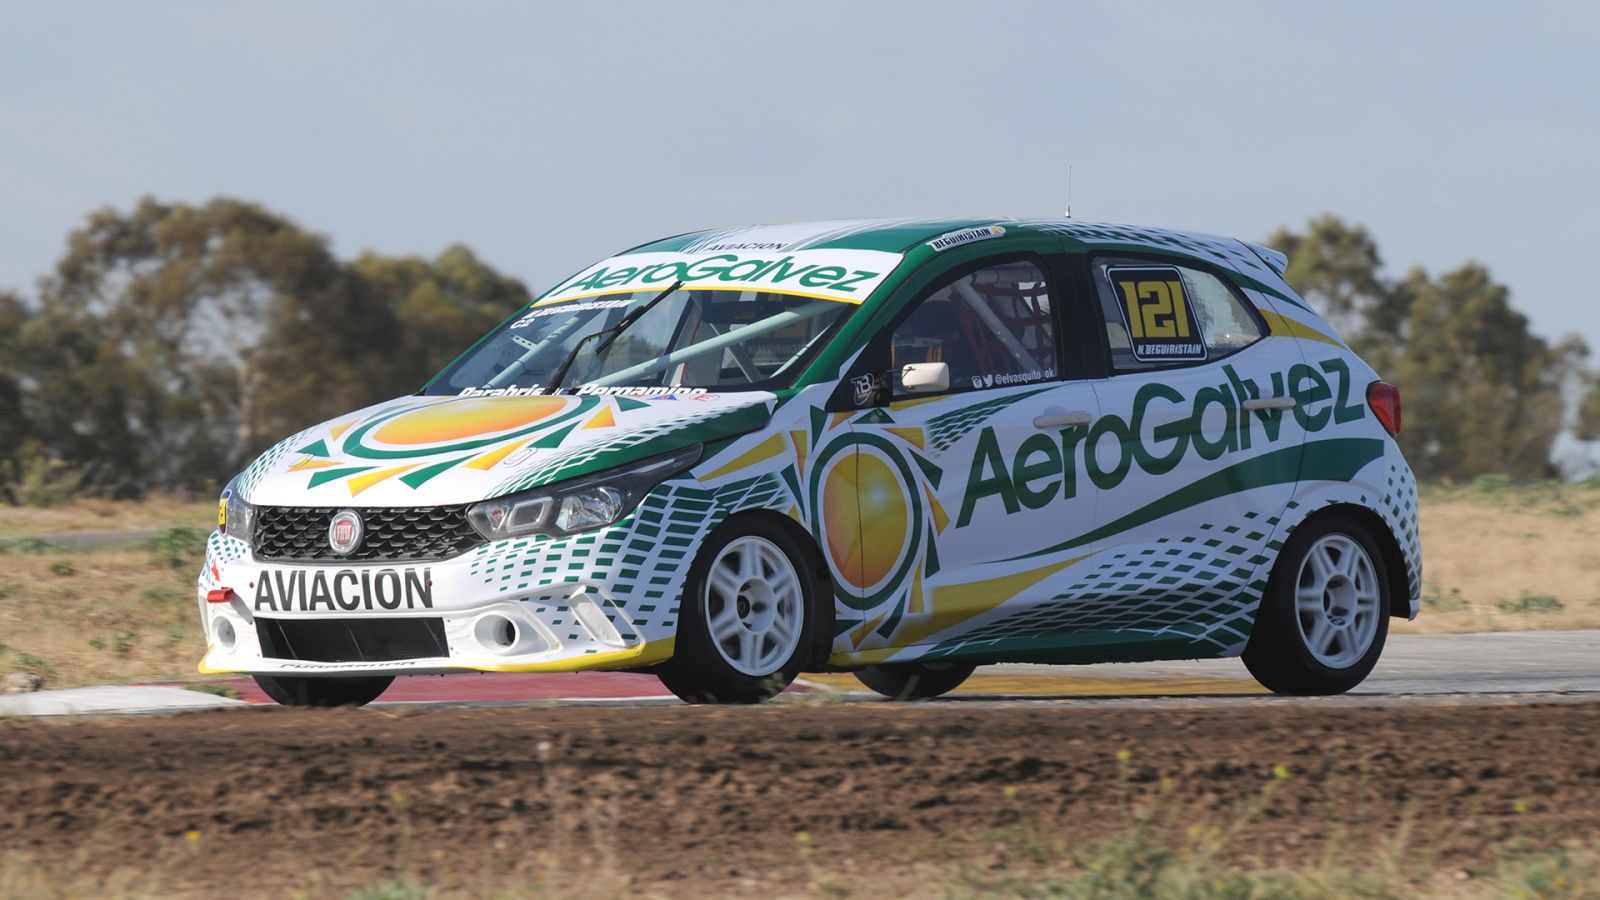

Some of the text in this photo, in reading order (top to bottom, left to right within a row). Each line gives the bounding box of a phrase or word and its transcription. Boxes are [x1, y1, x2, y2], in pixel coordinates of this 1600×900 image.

[704, 242, 788, 251] AVIACION
[933, 227, 991, 249] BEGUIRISTAIN
[549, 254, 881, 296] AeroGalvez
[1119, 281, 1190, 338] 121
[994, 367, 1056, 385] @elvasquito_ok
[955, 358, 1366, 529] AeroGalvez
[336, 524, 352, 541] FIAT
[254, 567, 434, 612] AVIACION
